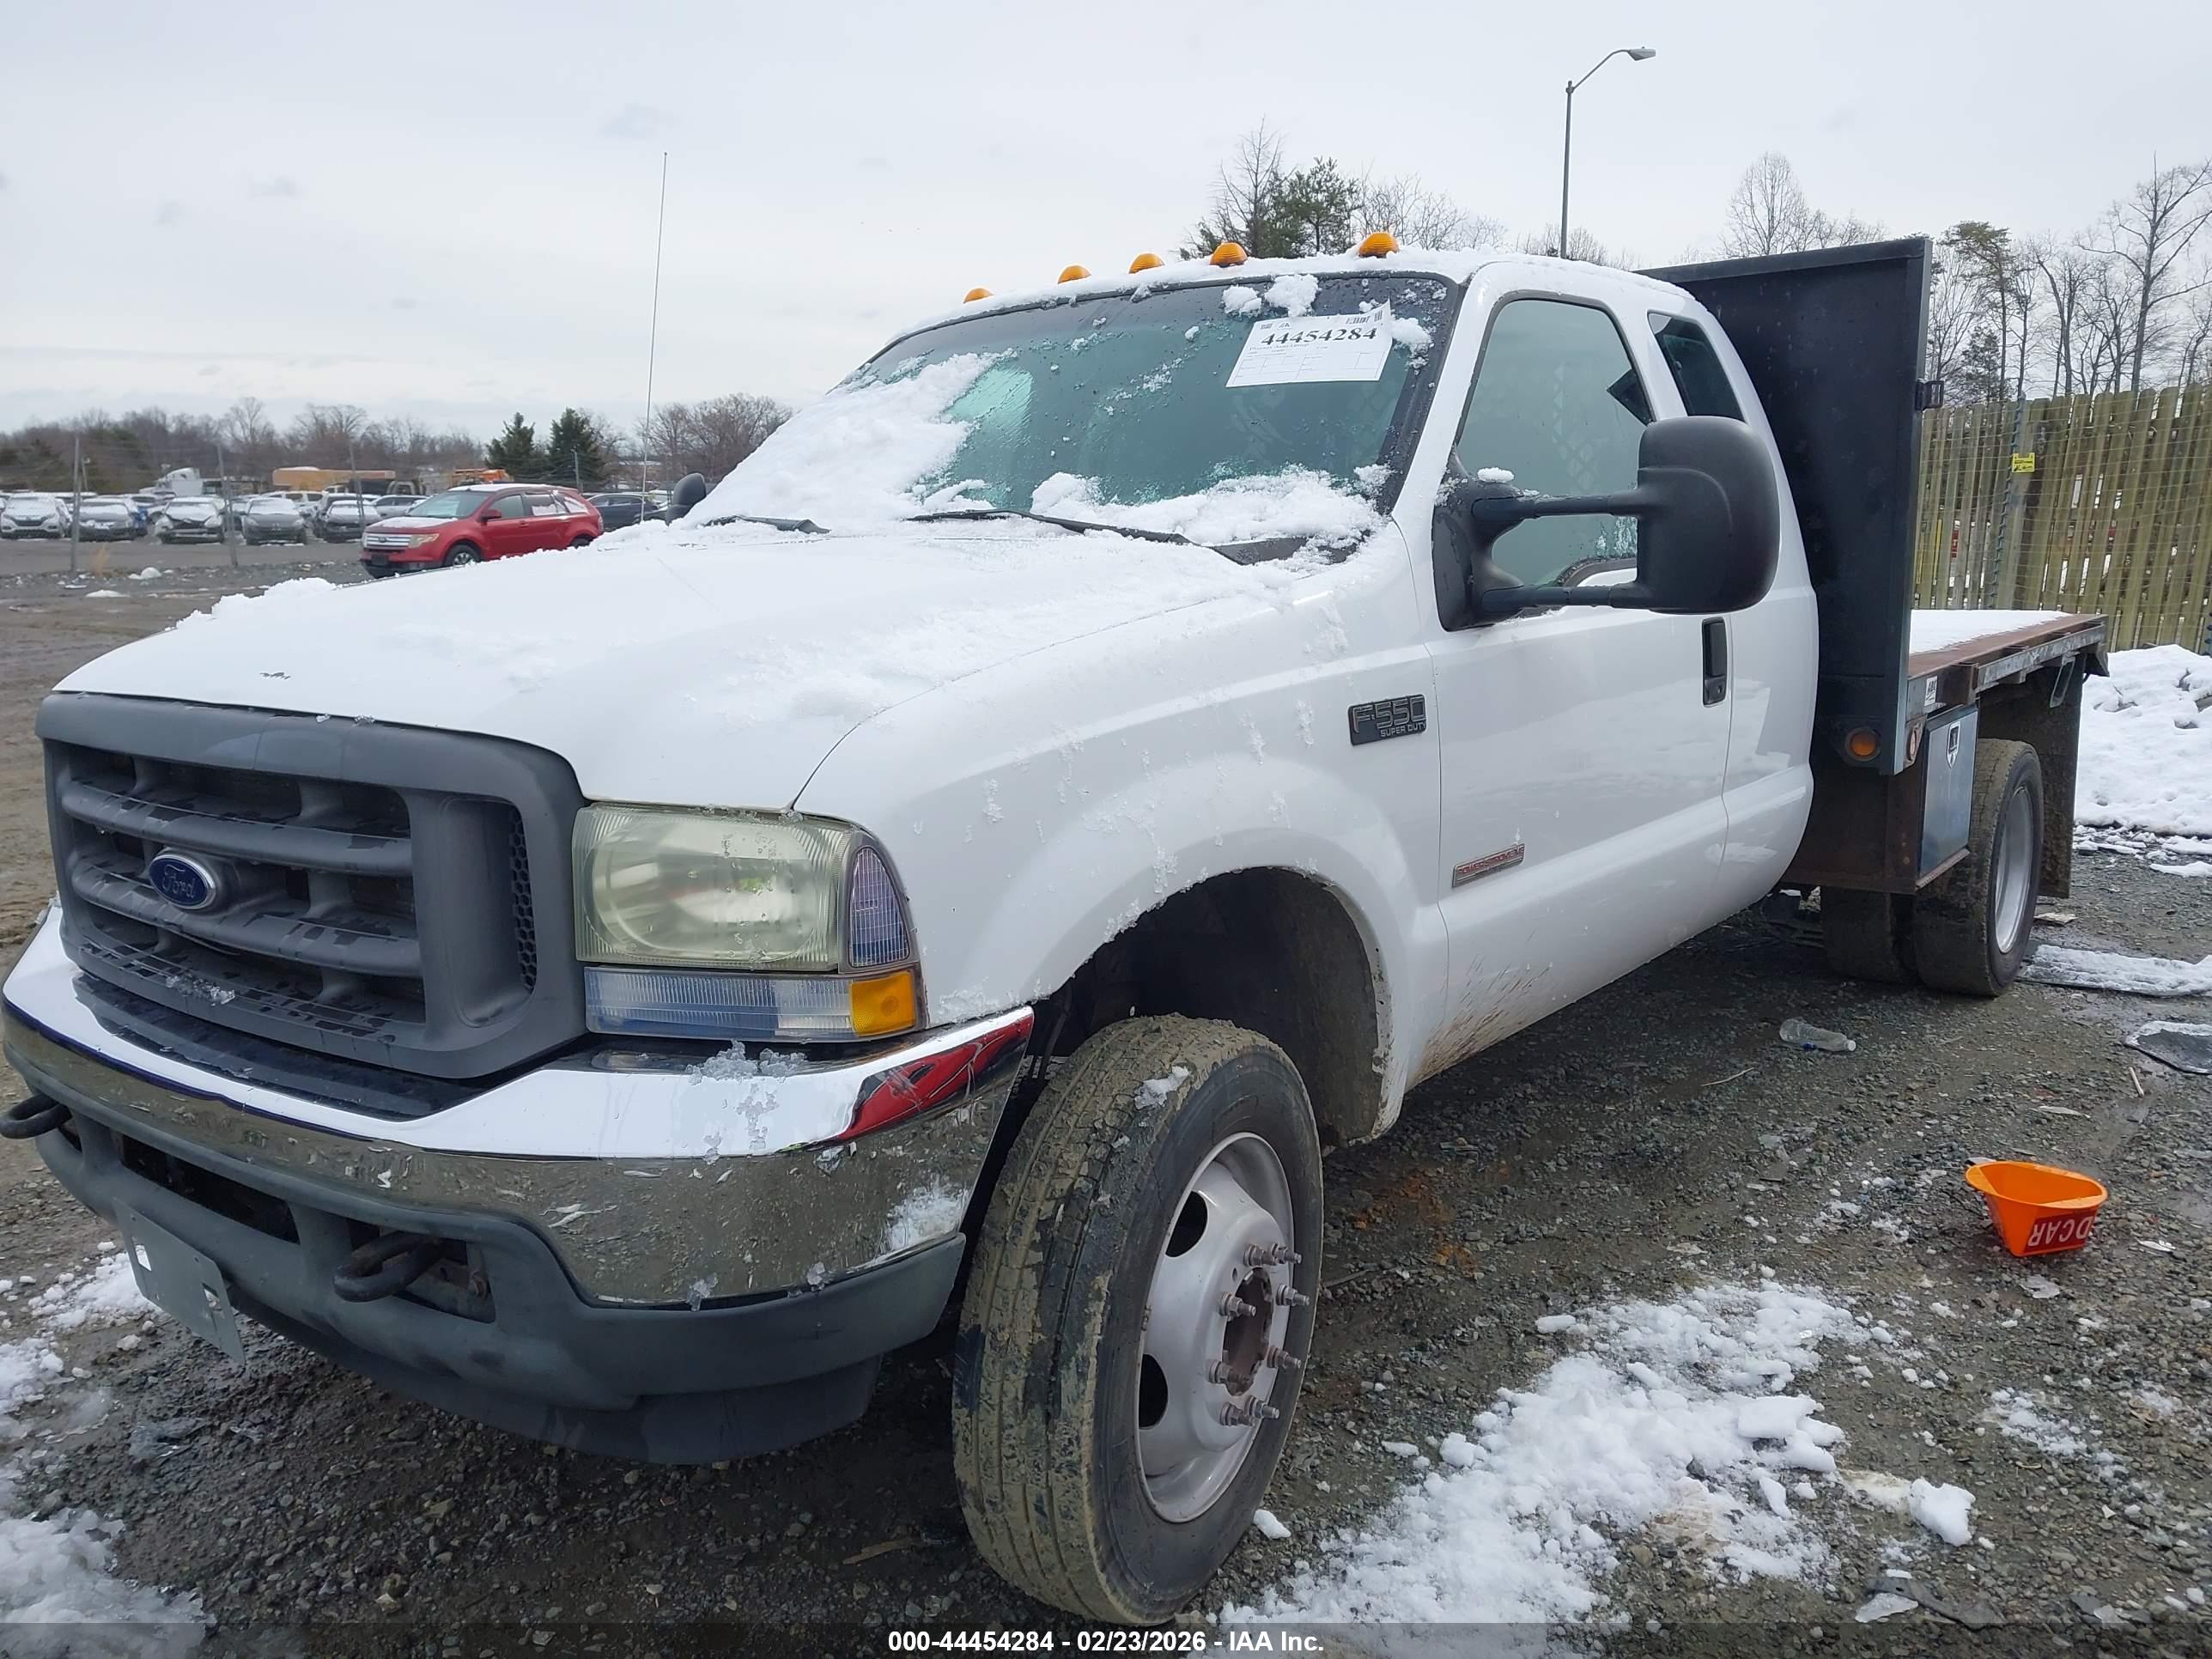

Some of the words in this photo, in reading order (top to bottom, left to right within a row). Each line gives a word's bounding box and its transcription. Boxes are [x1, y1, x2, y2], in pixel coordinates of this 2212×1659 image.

[1261, 327, 1376, 345] 44454284
[1380, 726, 1407, 737] SUPER
[1407, 722, 1426, 732] DUTY
[162, 864, 195, 899] Ford
